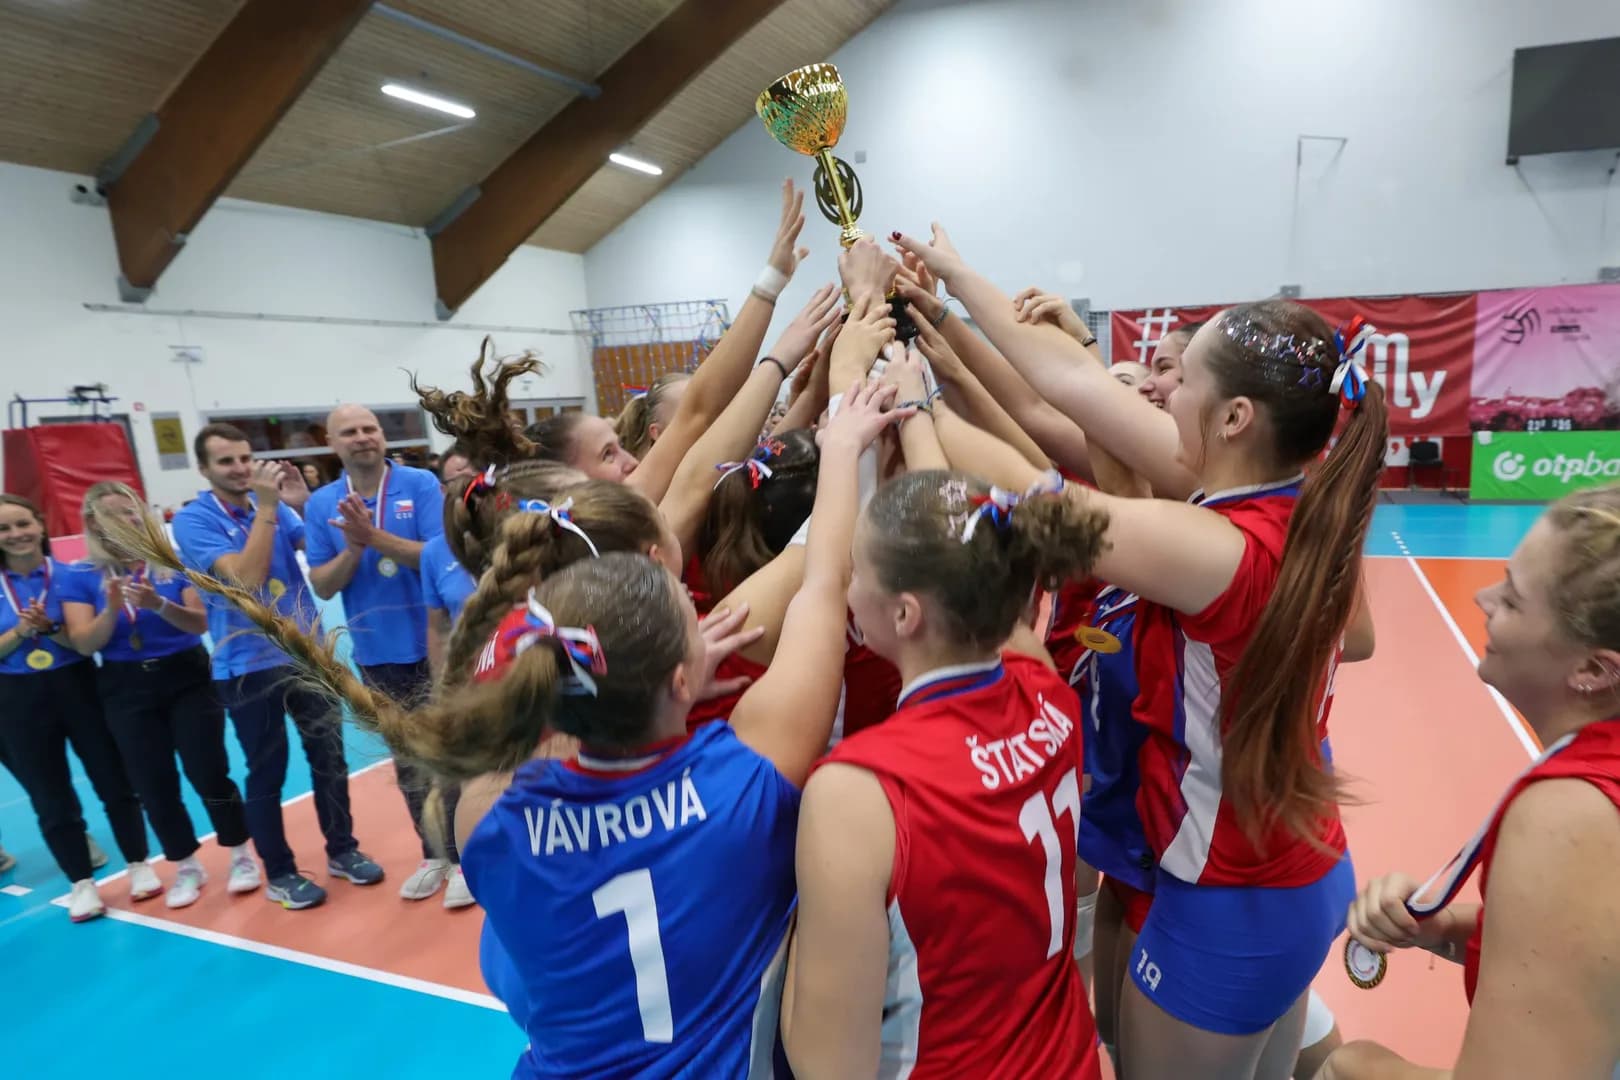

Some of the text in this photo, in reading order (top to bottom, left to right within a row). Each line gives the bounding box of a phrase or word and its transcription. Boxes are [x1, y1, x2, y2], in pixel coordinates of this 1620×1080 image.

[524, 766, 707, 857] VÁVROVÁ
[592, 867, 674, 1044] 1
[1136, 948, 1162, 992] 19
